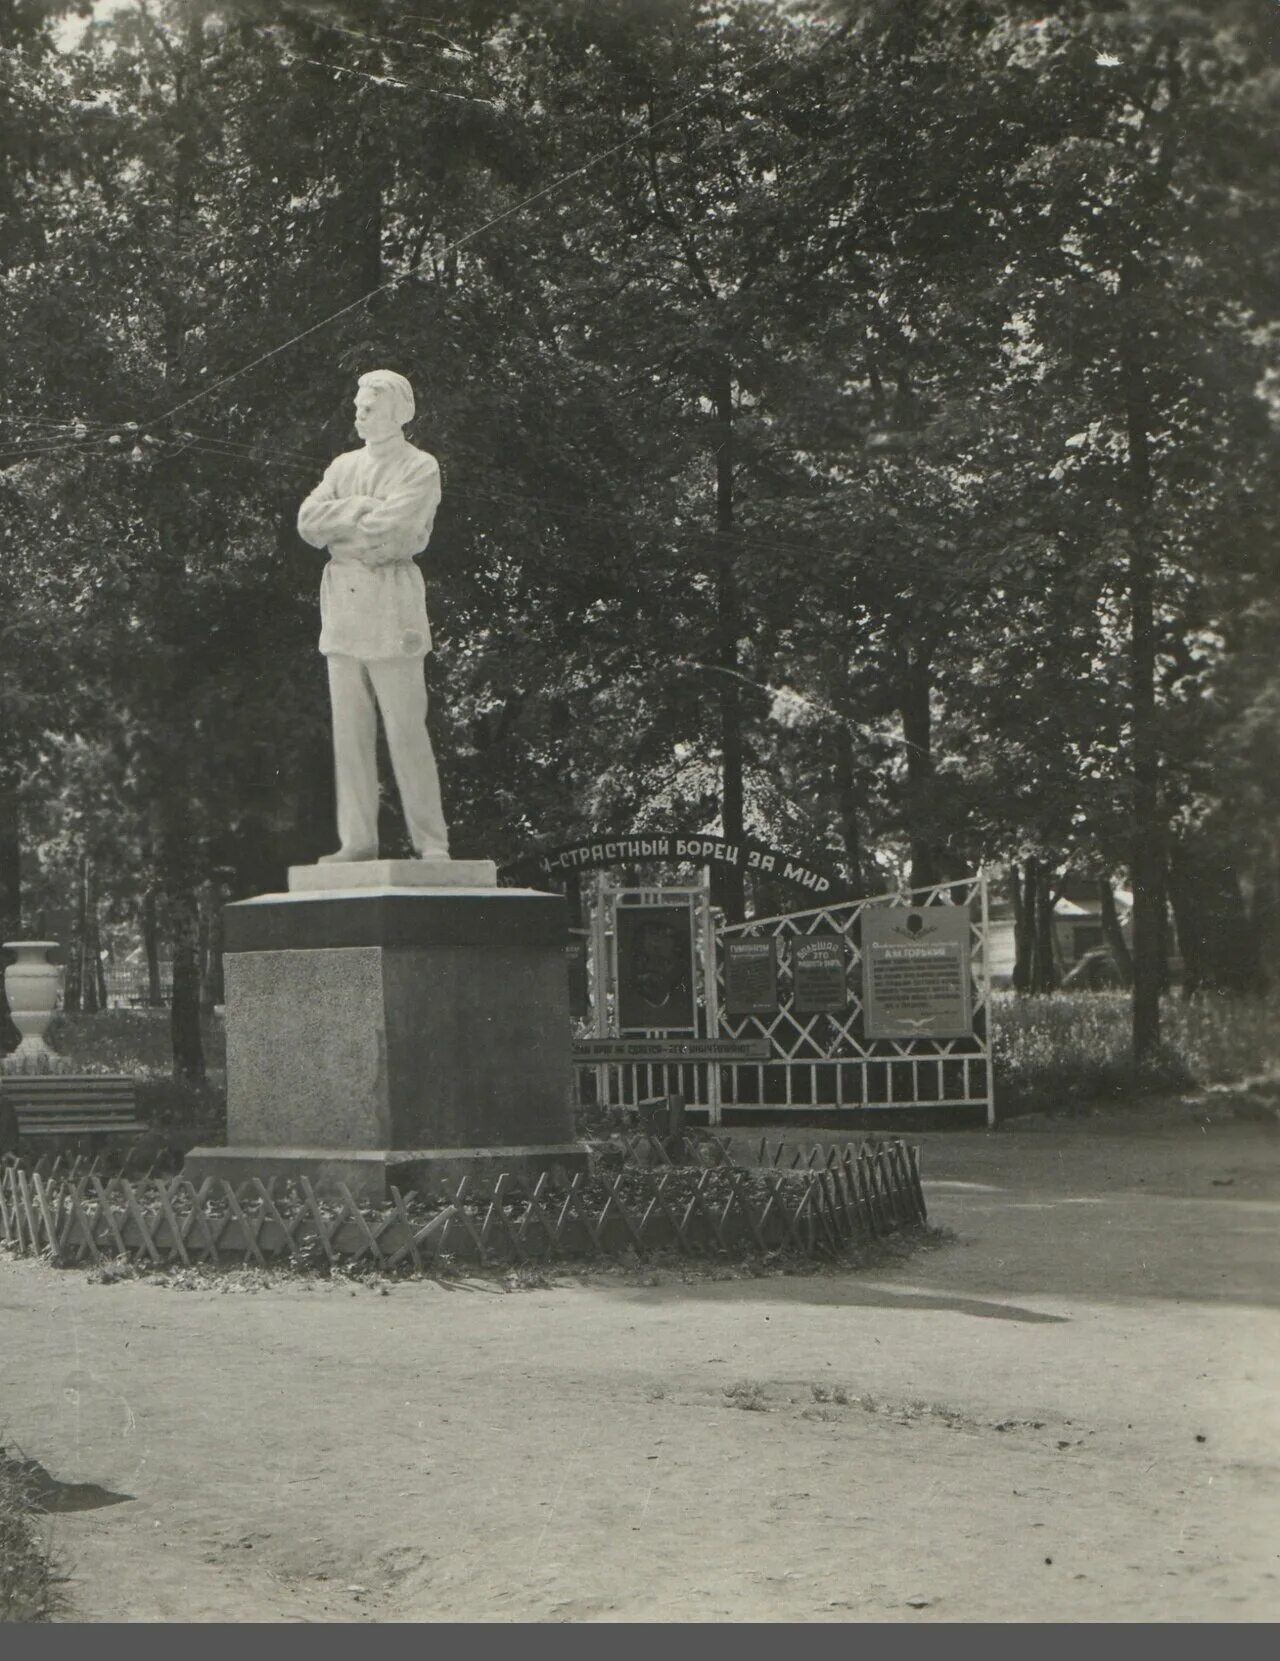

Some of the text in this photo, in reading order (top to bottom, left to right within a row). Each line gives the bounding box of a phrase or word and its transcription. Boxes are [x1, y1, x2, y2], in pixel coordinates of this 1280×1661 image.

[676, 839, 739, 865] БОРЕЦ
[747, 850, 776, 872] ЗА
[783, 862, 830, 892] МИР
